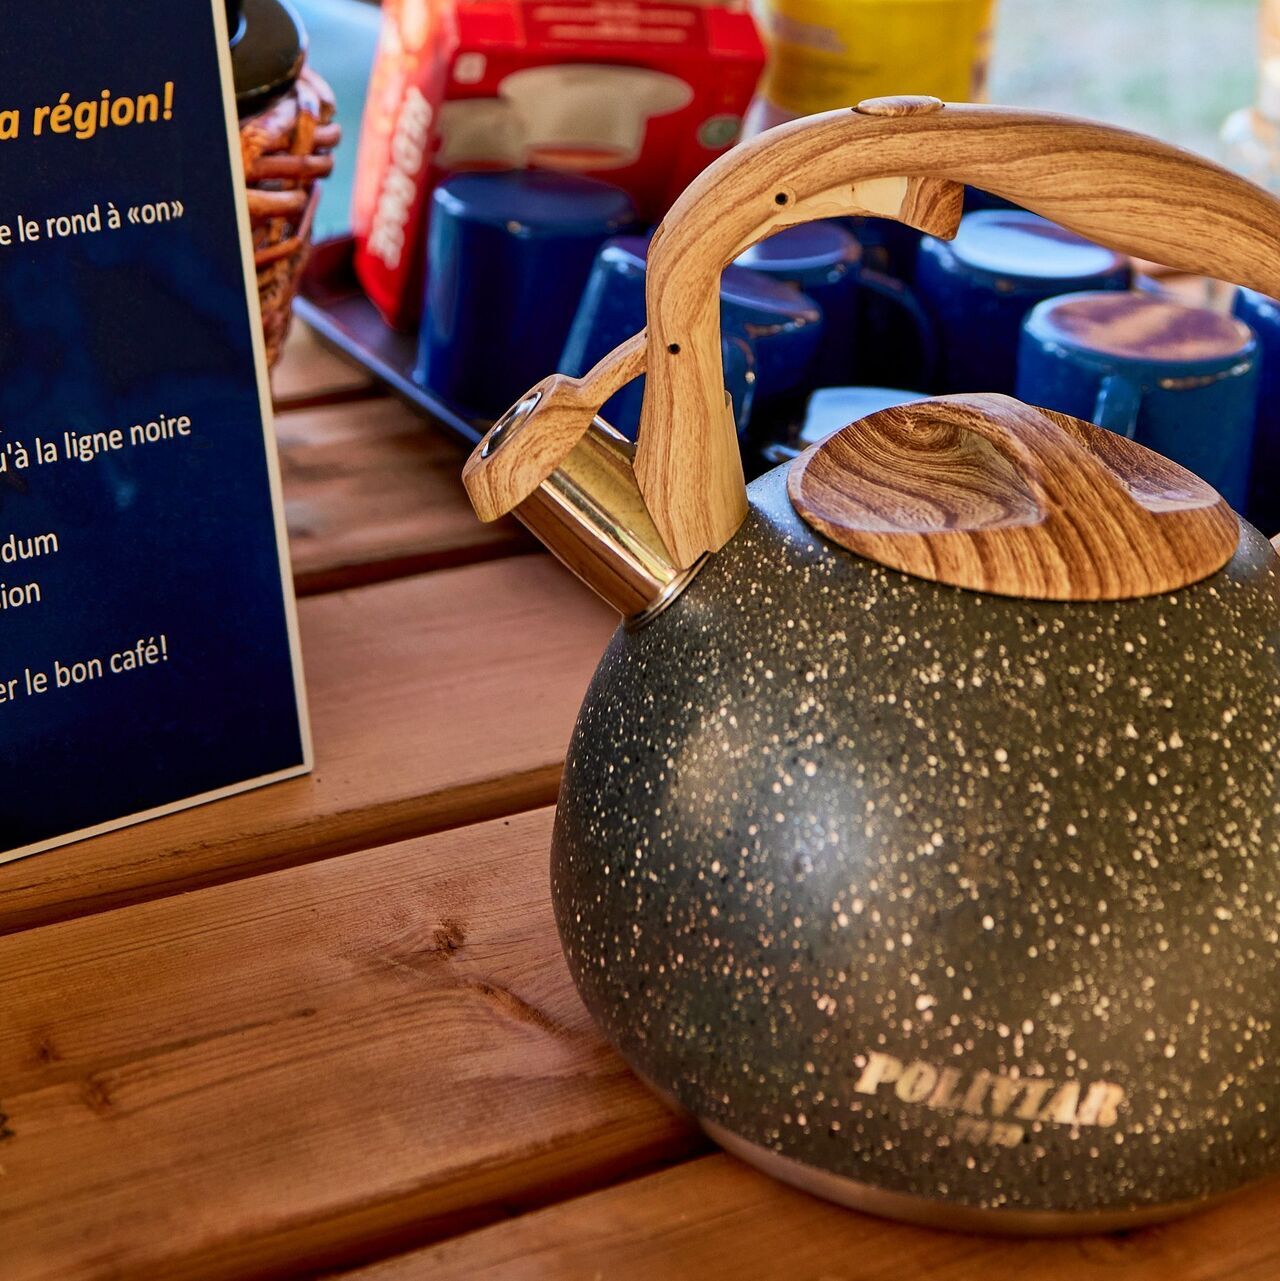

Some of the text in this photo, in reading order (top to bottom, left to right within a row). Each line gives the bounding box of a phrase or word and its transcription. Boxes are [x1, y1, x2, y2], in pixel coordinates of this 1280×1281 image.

[33, 81, 174, 139] région!
[18, 215, 39, 242] le
[46, 204, 101, 238] rond
[108, 202, 121, 229] à
[128, 201, 184, 224] «on»
[36, 438, 57, 464] la
[64, 430, 123, 462] ligne
[130, 414, 191, 445] noire
[25, 668, 47, 695] le
[55, 659, 102, 688] bon
[110, 635, 168, 673] café!
